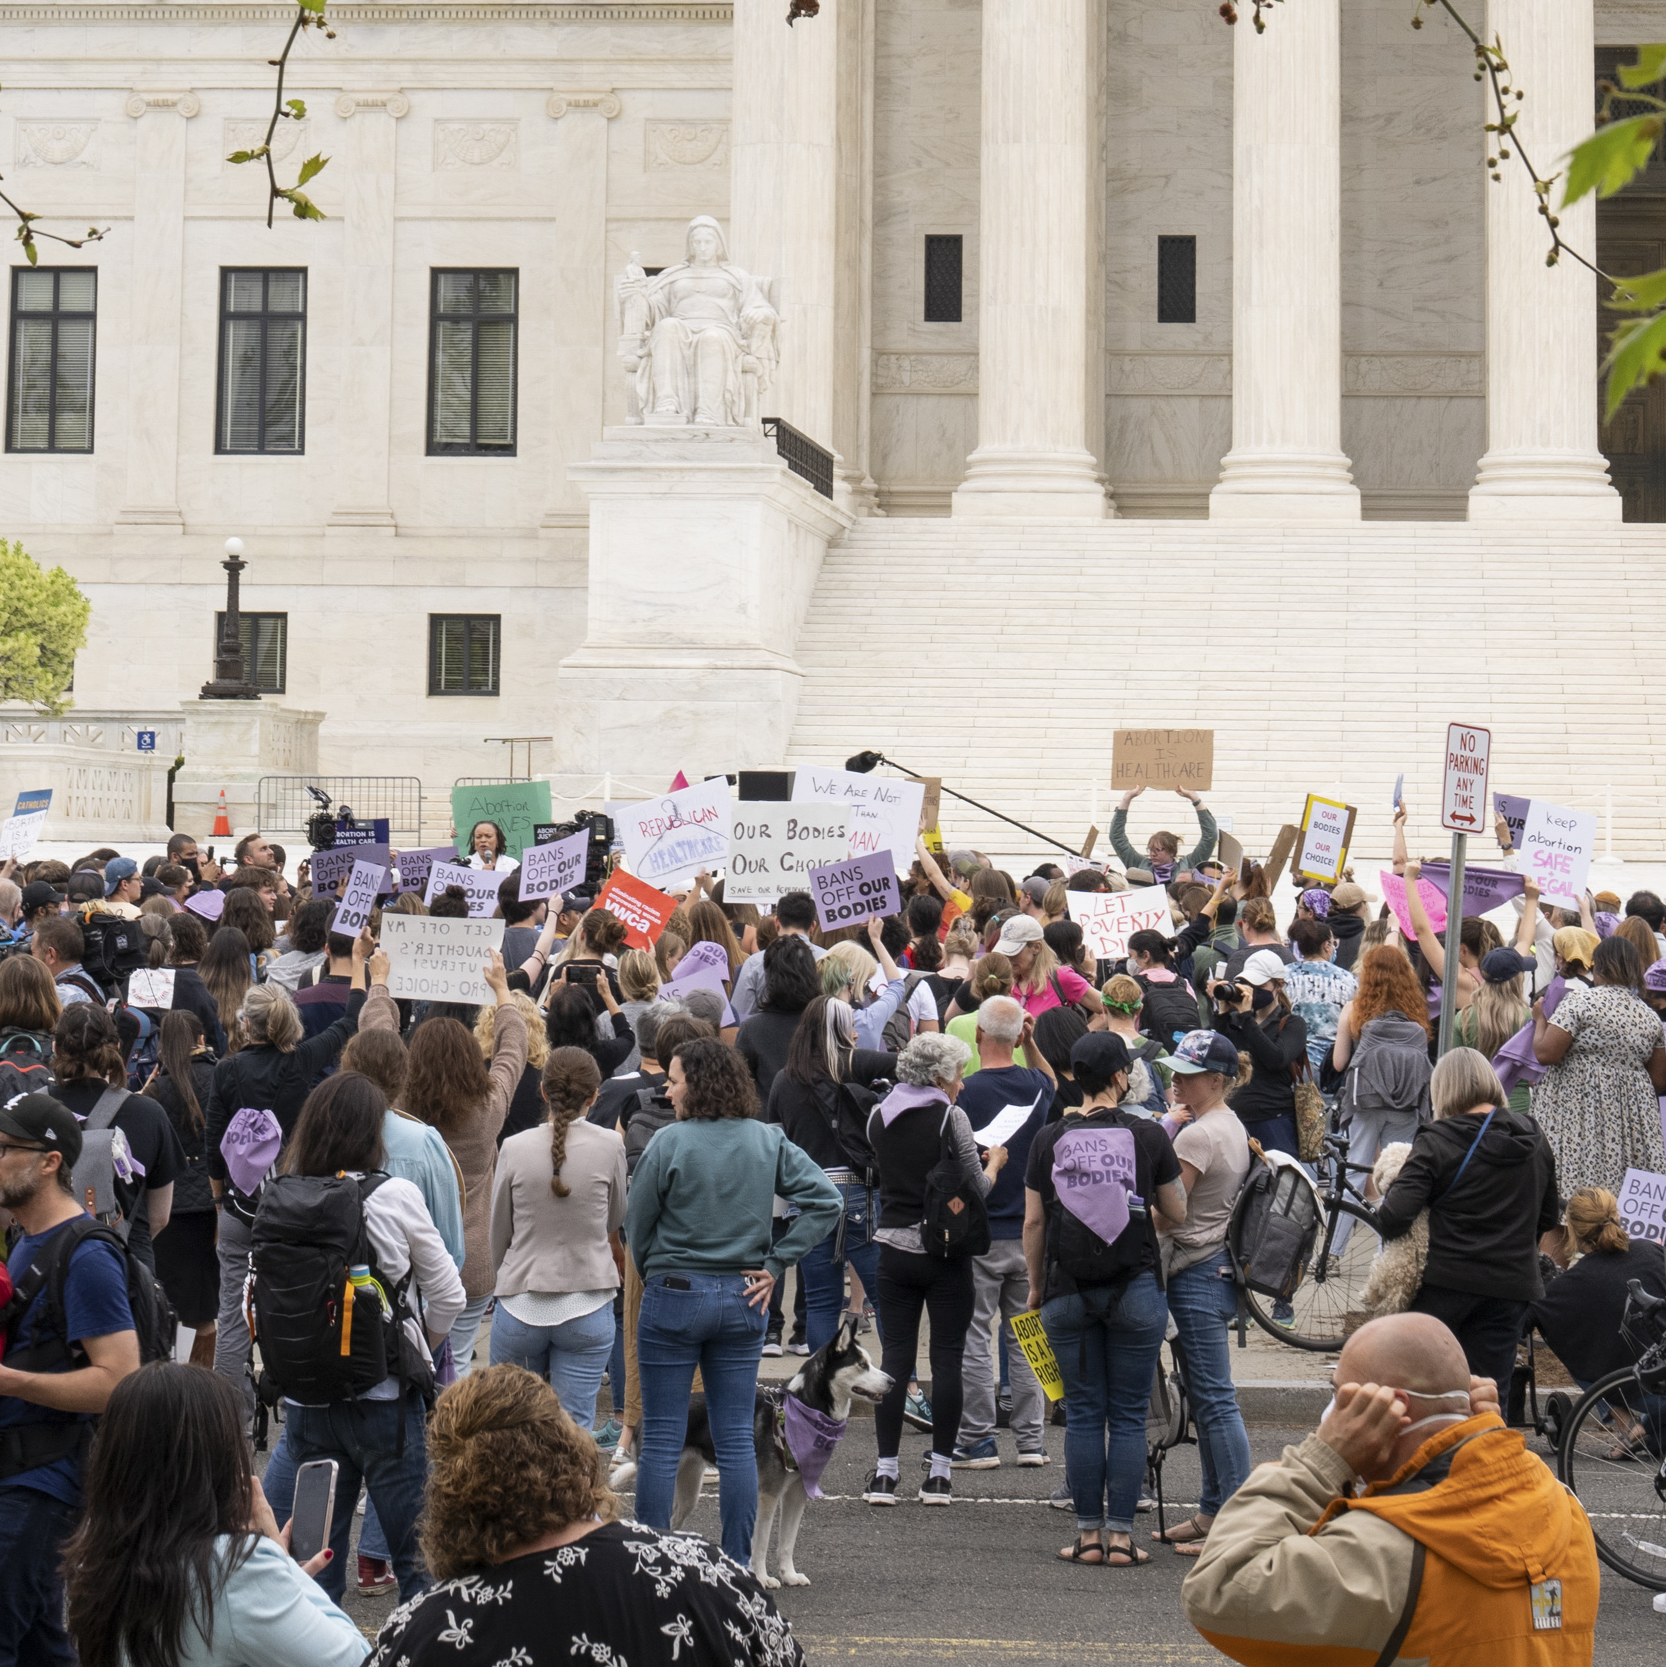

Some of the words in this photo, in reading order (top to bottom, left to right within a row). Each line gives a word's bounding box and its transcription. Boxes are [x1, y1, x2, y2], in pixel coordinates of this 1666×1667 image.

[1123, 730, 1207, 746] ABORTION
[1460, 732, 1476, 753] NO
[1154, 748, 1178, 760] IS
[1448, 752, 1485, 776] PARKING
[1116, 761, 1205, 779] HEALTHCARE
[812, 776, 837, 795] WE
[844, 784, 868, 797] ARE
[873, 786, 901, 803] NOT
[1455, 776, 1474, 793] ANY
[17, 799, 49, 810] CATHOLICS
[468, 797, 531, 818] Abortion
[1454, 792, 1475, 810] TIME
[493, 816, 532, 833] AVES
[638, 805, 719, 838] REPUBLICAN
[1321, 811, 1337, 822] OUR
[12, 831, 21, 841] IS
[23, 830, 28, 839] A
[336, 830, 366, 838] BORTION
[734, 821, 772, 840] OUR
[1313, 821, 1341, 835] BODIES
[335, 838, 356, 846] EALTH
[1315, 842, 1331, 853] OUR
[1528, 831, 1582, 855] abortion
[316, 852, 355, 870] BANS
[401, 854, 432, 865] BANS
[528, 846, 564, 867] BANS
[647, 835, 724, 873] HEALTHCARE
[732, 853, 770, 875] OUR
[780, 851, 842, 872] CHOIC
[1305, 852, 1335, 867] CHOICE!
[1532, 849, 1574, 875] SAFE
[317, 866, 345, 881] OFF
[401, 865, 424, 876] OFF
[436, 868, 475, 885] BANS
[527, 865, 555, 881] OFF
[557, 853, 582, 874] OUR
[354, 870, 381, 891] BANS
[402, 877, 428, 887] BOD
[525, 870, 576, 894] BODIES
[817, 866, 863, 890] BANS
[1475, 875, 1499, 890] OUR
[1536, 876, 1576, 899] EGAL
[347, 890, 371, 909] OFF
[730, 886, 753, 894] SAVE
[758, 886, 771, 894] OUR
[821, 885, 855, 906] OFF
[858, 876, 891, 896] OUR
[608, 892, 642, 915] empowering
[642, 911, 662, 925] women
[611, 887, 642, 908] eliminating
[642, 904, 661, 917] racism
[824, 895, 887, 923] BODIES
[1094, 893, 1133, 917] LET
[339, 908, 369, 929] BOD
[703, 945, 727, 964] OUR
[1099, 936, 1126, 956] DI
[691, 949, 719, 967] DIES
[1064, 1139, 1109, 1158] BANS
[1064, 1155, 1097, 1172] OFF
[1100, 1154, 1133, 1174] OUR
[1622, 1198, 1661, 1220] OFF
[1618, 1216, 1666, 1241] BODI
[1014, 1314, 1044, 1342] ABORT
[1023, 1343, 1039, 1364] IS
[1035, 1340, 1048, 1360] A
[1034, 1360, 1061, 1386] RIGH
